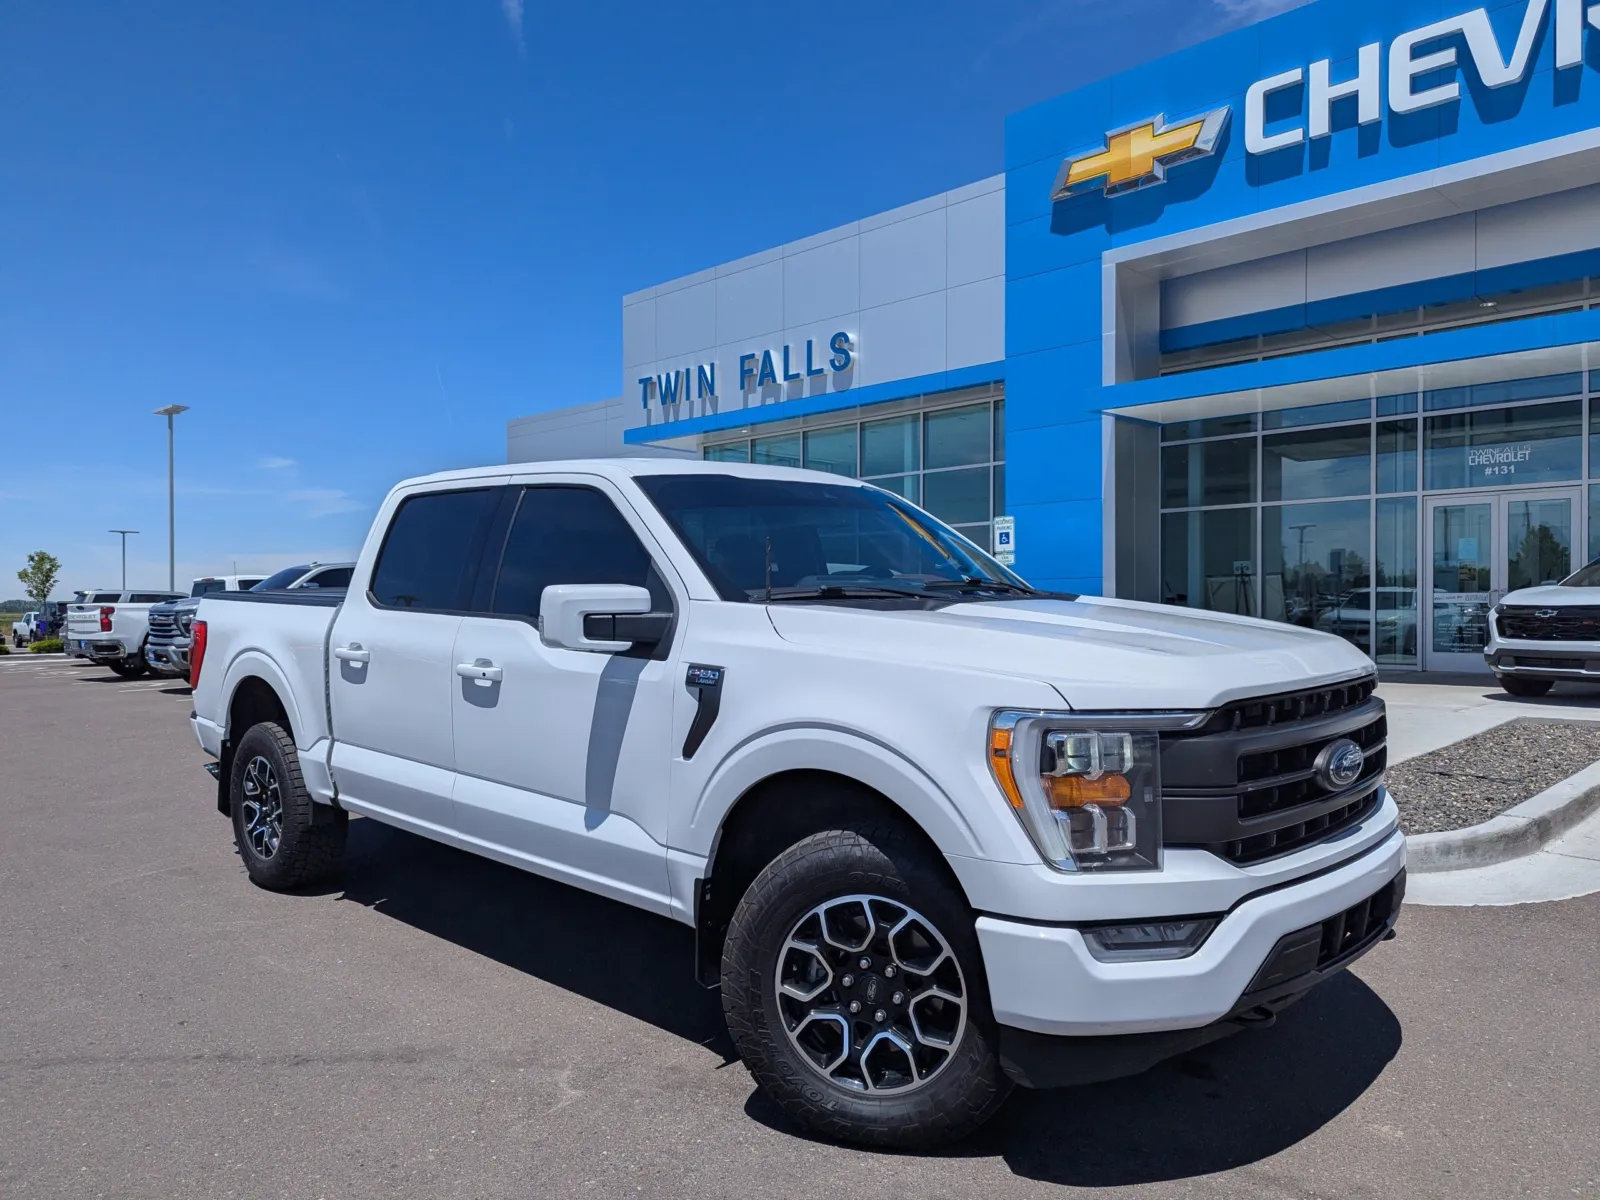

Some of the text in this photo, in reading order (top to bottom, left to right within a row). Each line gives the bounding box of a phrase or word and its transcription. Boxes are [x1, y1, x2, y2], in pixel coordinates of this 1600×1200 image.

[638, 331, 854, 409] TWIN FALLS
[1468, 451, 1531, 466] CHEVROLET
[1484, 465, 1515, 476] #131
[775, 1059, 840, 1113] TOYO
